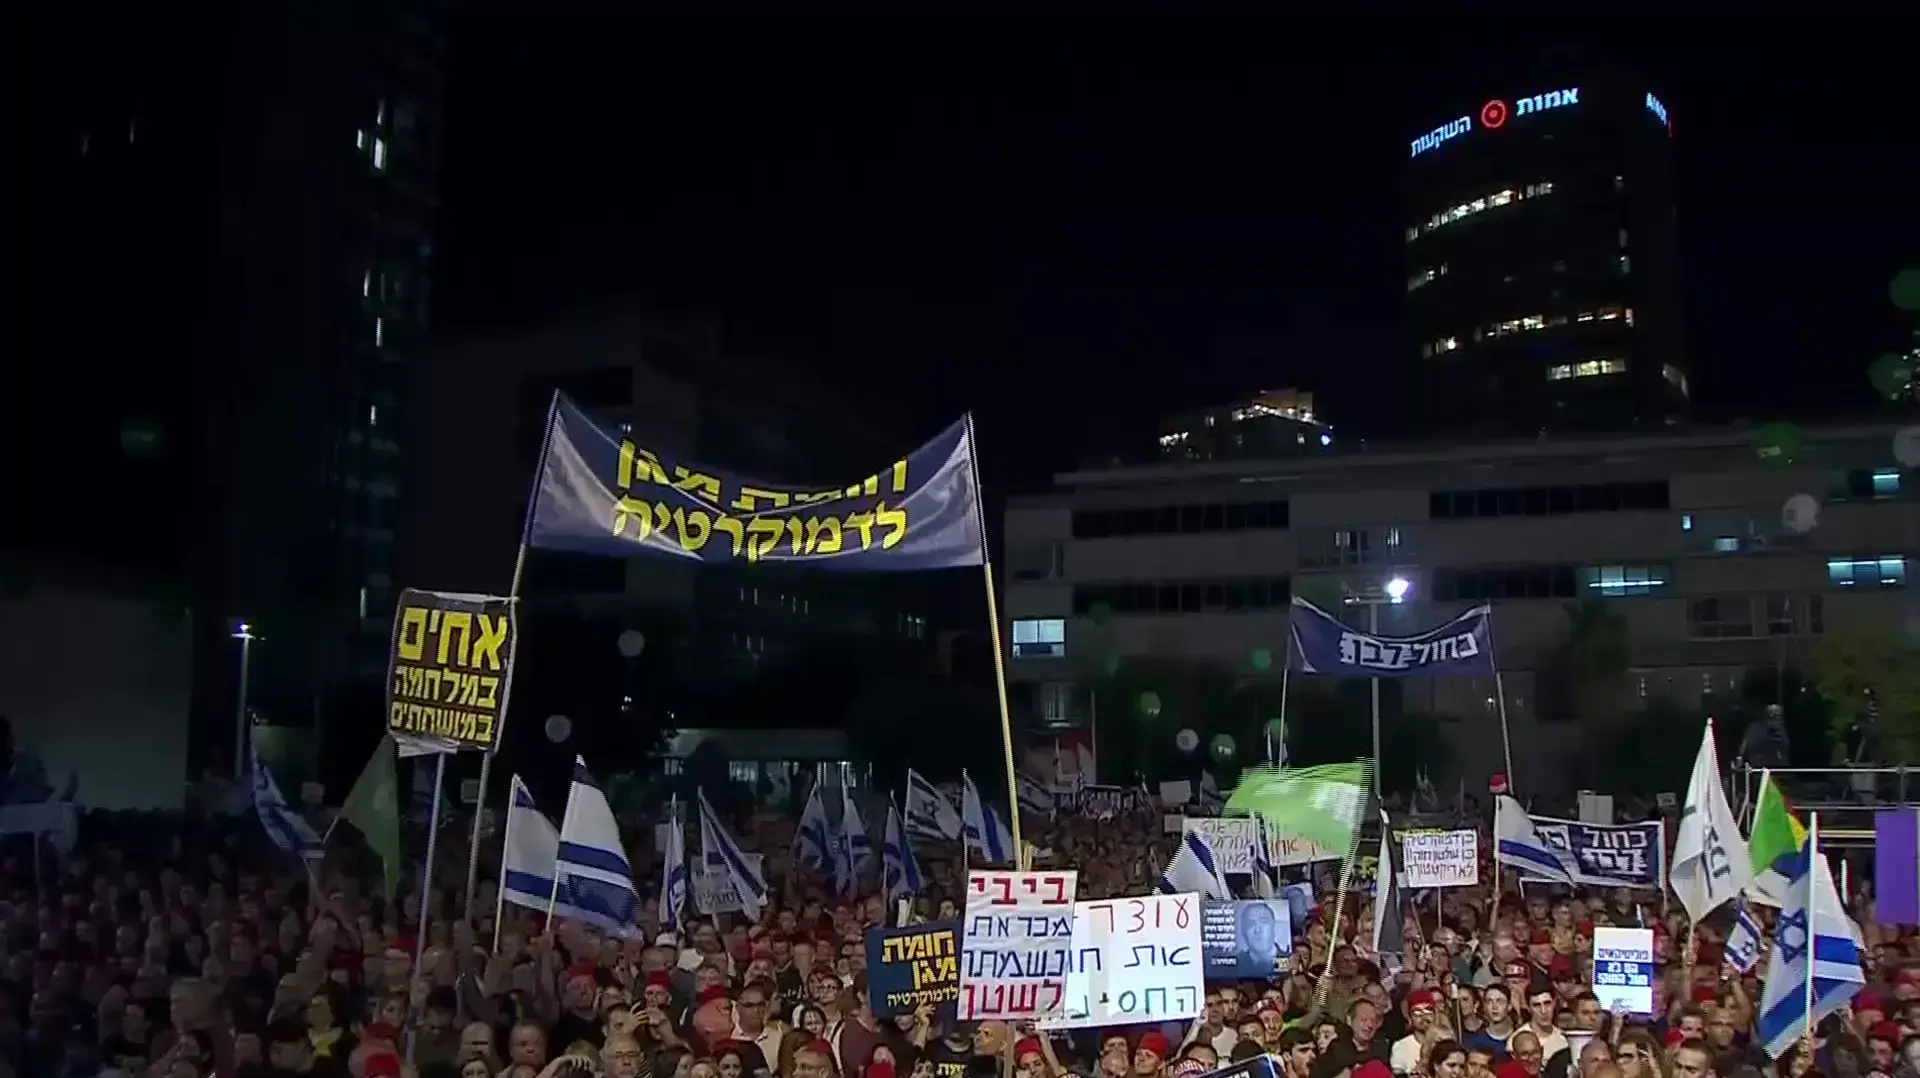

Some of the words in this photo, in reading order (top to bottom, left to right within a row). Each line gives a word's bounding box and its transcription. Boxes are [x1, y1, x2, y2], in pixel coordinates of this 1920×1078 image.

[1516, 88, 1579, 117] אמות
[1411, 115, 1471, 158] השקעות
[612, 494, 908, 564] לדמוקרטיה
[396, 606, 508, 671] אחים
[1413, 632, 1478, 665] כחול
[394, 664, 500, 710] במלחמה
[390, 700, 495, 744] במושחתים
[1582, 827, 1648, 849] כחול
[1458, 862, 1474, 879] לא
[970, 877, 1069, 905] ביבי
[967, 916, 1010, 938] את
[1017, 916, 1072, 938] מכר
[1088, 898, 1190, 933] עוצר
[882, 930, 955, 963] חומת
[1069, 948, 1101, 973] חו
[1123, 945, 1191, 968] את
[912, 956, 958, 990] מגן
[887, 984, 960, 1009] לדמוקרטיה
[962, 979, 1062, 1020] לשטן
